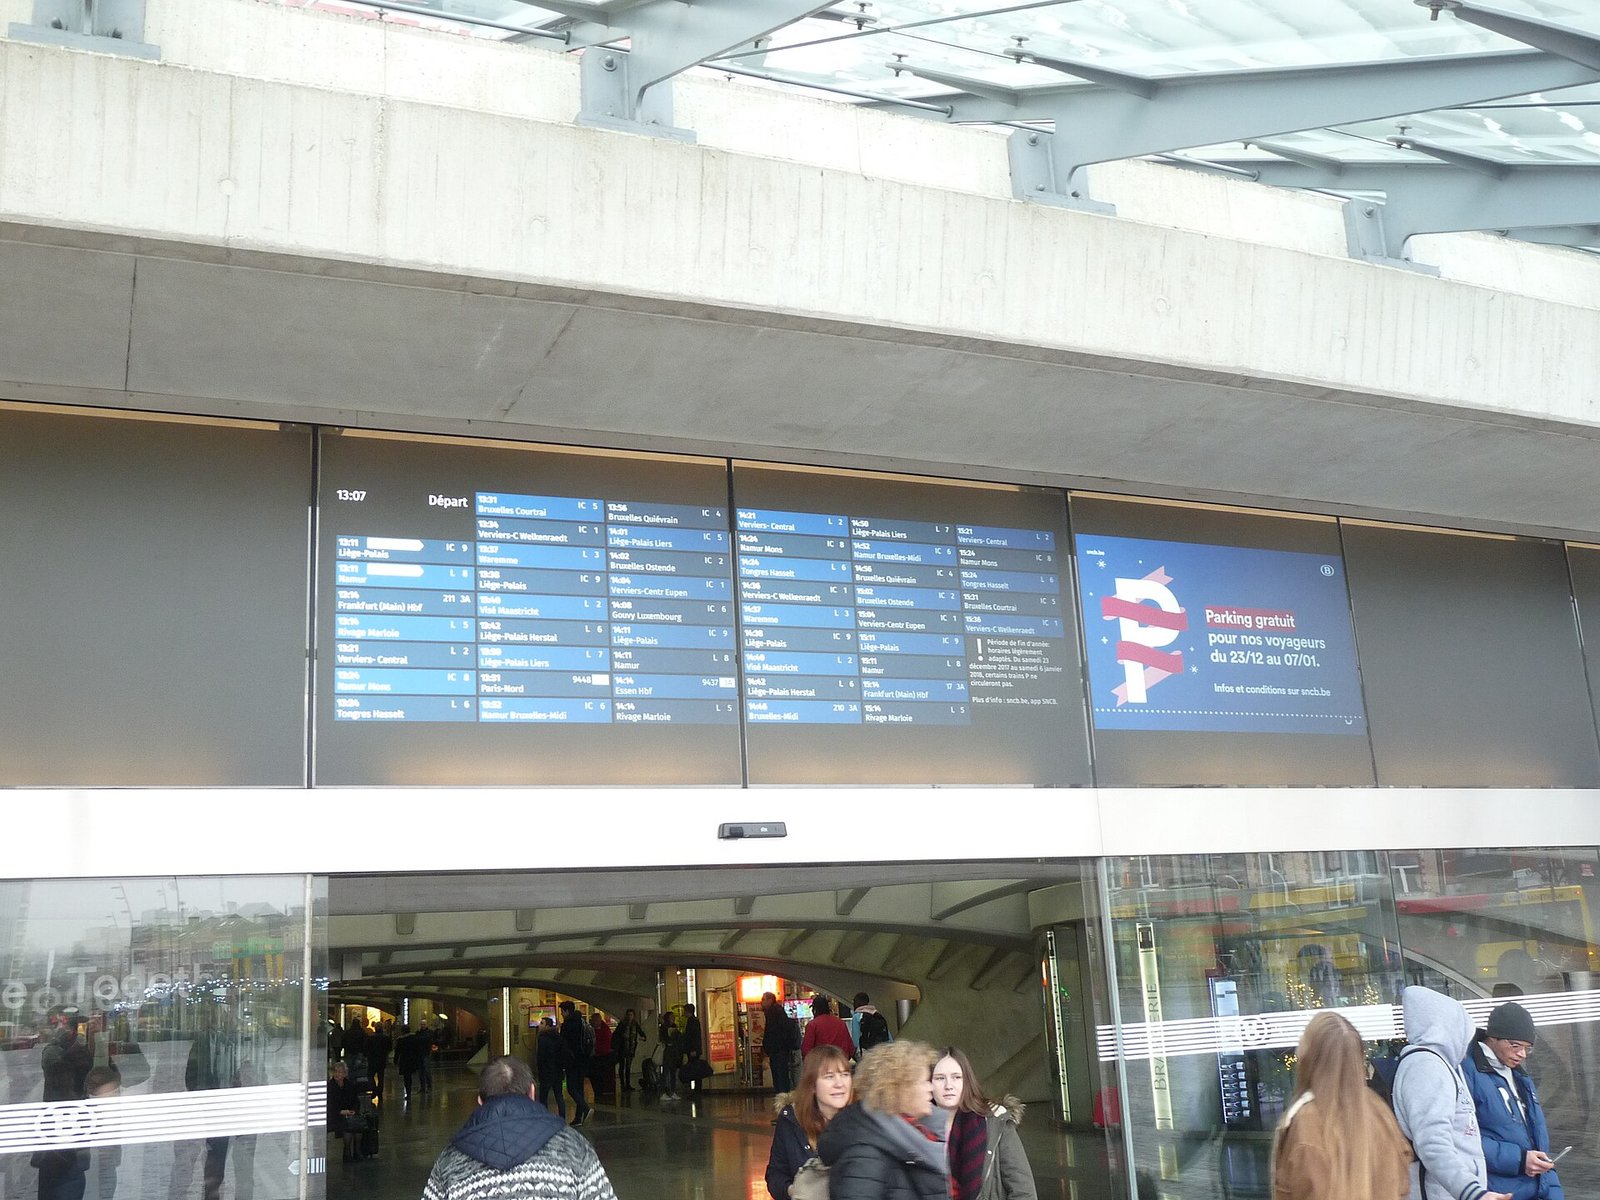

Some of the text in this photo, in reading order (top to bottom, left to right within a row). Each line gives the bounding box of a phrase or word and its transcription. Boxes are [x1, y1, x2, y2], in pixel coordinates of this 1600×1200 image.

[336, 490, 366, 501] 13:07
[429, 495, 468, 508] Départ
[478, 506, 546, 516] Bruxelles Courtrai
[608, 513, 678, 524] Bruxelles Quiévrain
[771, 522, 795, 531] Central
[478, 530, 518, 540] Verviers-C
[646, 564, 676, 572] Ostende
[856, 574, 885, 582] Bruxelles
[962, 580, 986, 589] Tongres
[611, 587, 688, 597] Verviers-Centr Eupen
[742, 591, 778, 600] Verviers-C
[338, 602, 423, 612] Frankfurt (Main) Hbf
[612, 611, 682, 622] Gouvy Luxembourg
[1206, 609, 1296, 628] Parking gratuit
[529, 634, 558, 642] Herstal
[1208, 633, 1326, 651] pour nos voyageurs
[377, 656, 408, 664] Central
[1211, 650, 1320, 668] du 23/12 au 07/01.
[481, 684, 524, 693] Paris-Nord
[1214, 683, 1331, 697] Infos et conditions sur sncb.be
[337, 710, 405, 720] Tongres Hasselt
[616, 712, 642, 722] Rivage
[865, 714, 887, 722] Rivage
[1147, 983, 1168, 1091] BRAERIE
